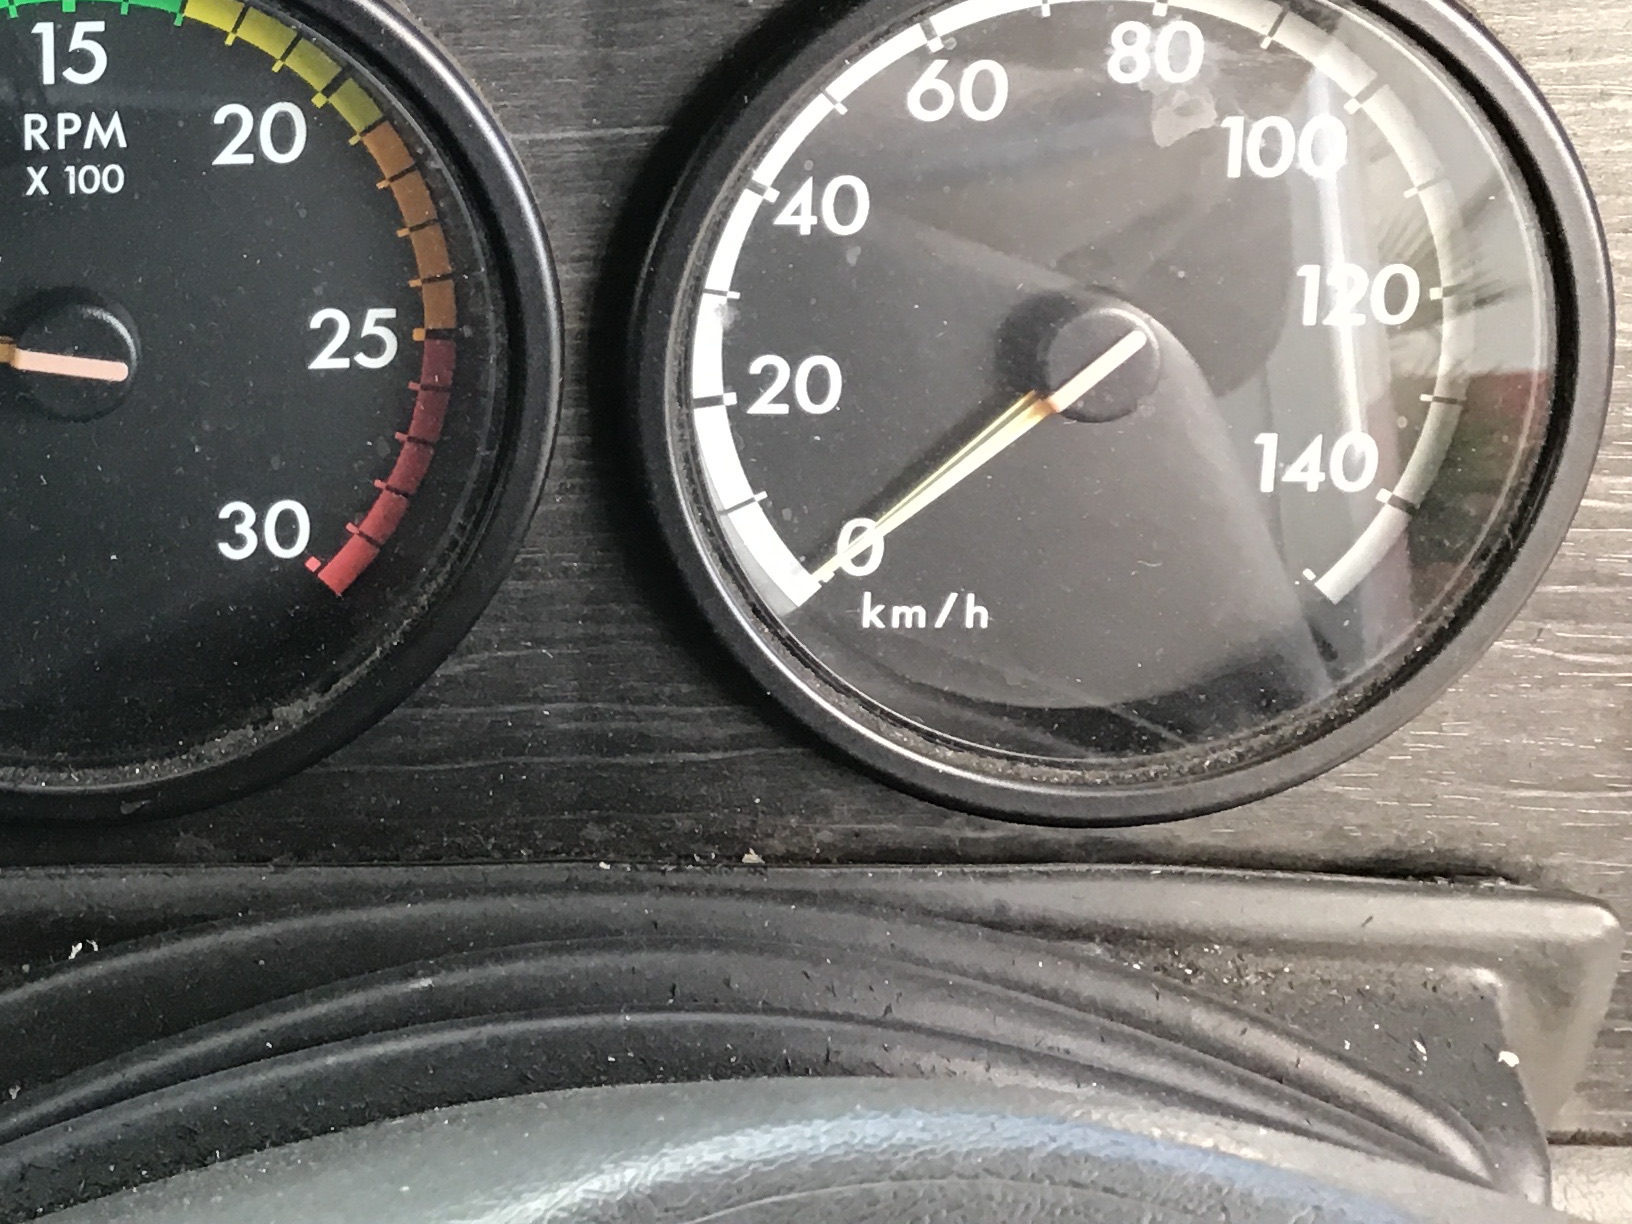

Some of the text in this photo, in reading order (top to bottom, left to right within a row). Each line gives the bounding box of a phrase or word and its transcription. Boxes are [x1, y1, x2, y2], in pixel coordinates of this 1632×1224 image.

[30, 21, 109, 86] 15
[1105, 20, 1205, 84] 80
[905, 59, 1010, 123] 60
[22, 112, 129, 152] RPM
[211, 102, 308, 166] 20
[1218, 114, 1348, 179] 100
[25, 163, 126, 196] X 100
[773, 173, 871, 236] 40
[1293, 263, 1421, 327] 120
[306, 307, 398, 371] 25
[746, 355, 843, 416] 20
[1252, 431, 1380, 494] 140
[217, 501, 312, 562] 30
[835, 518, 886, 576] 0
[860, 592, 990, 632] km/h
